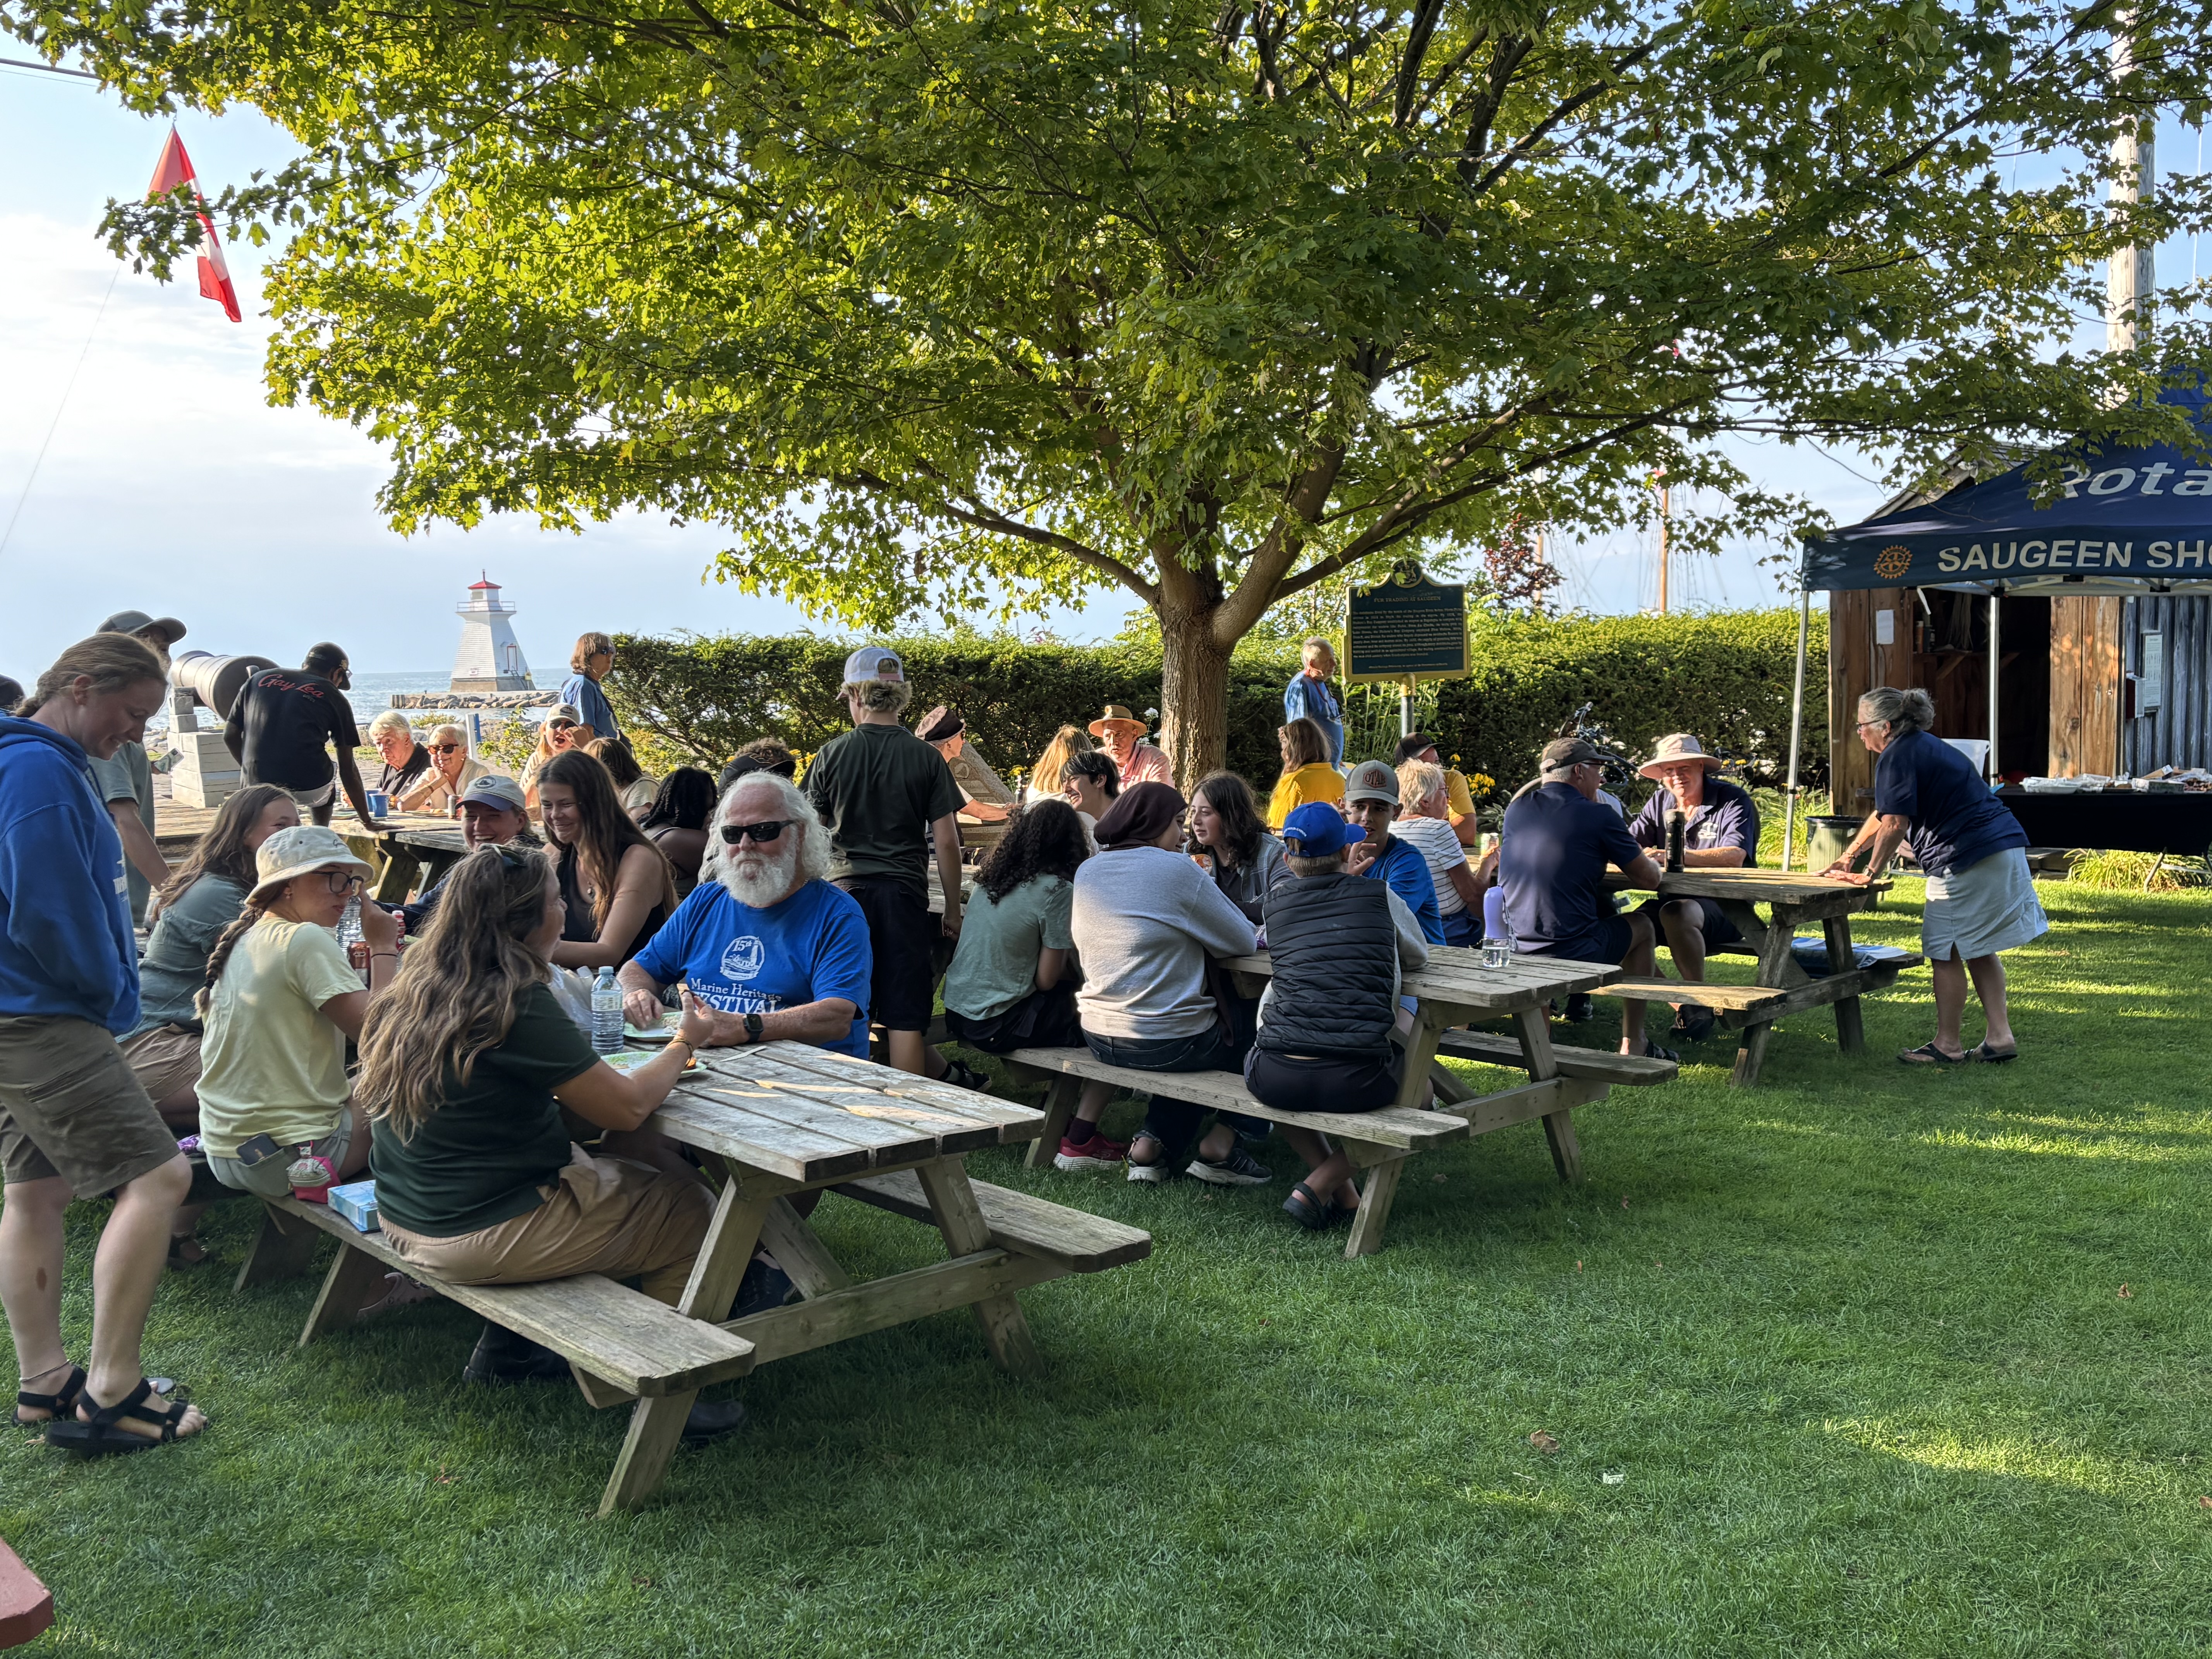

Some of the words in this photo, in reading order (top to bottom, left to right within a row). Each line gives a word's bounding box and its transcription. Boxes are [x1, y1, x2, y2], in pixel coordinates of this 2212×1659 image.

[1938, 540, 2133, 572] SAUGEEN
[2147, 540, 2212, 568] SH
[258, 674, 296, 691] Gay
[295, 683, 324, 698] Lea
[732, 940, 752, 952] 15th
[691, 978, 729, 994] Marine
[730, 983, 782, 1001] Heritage
